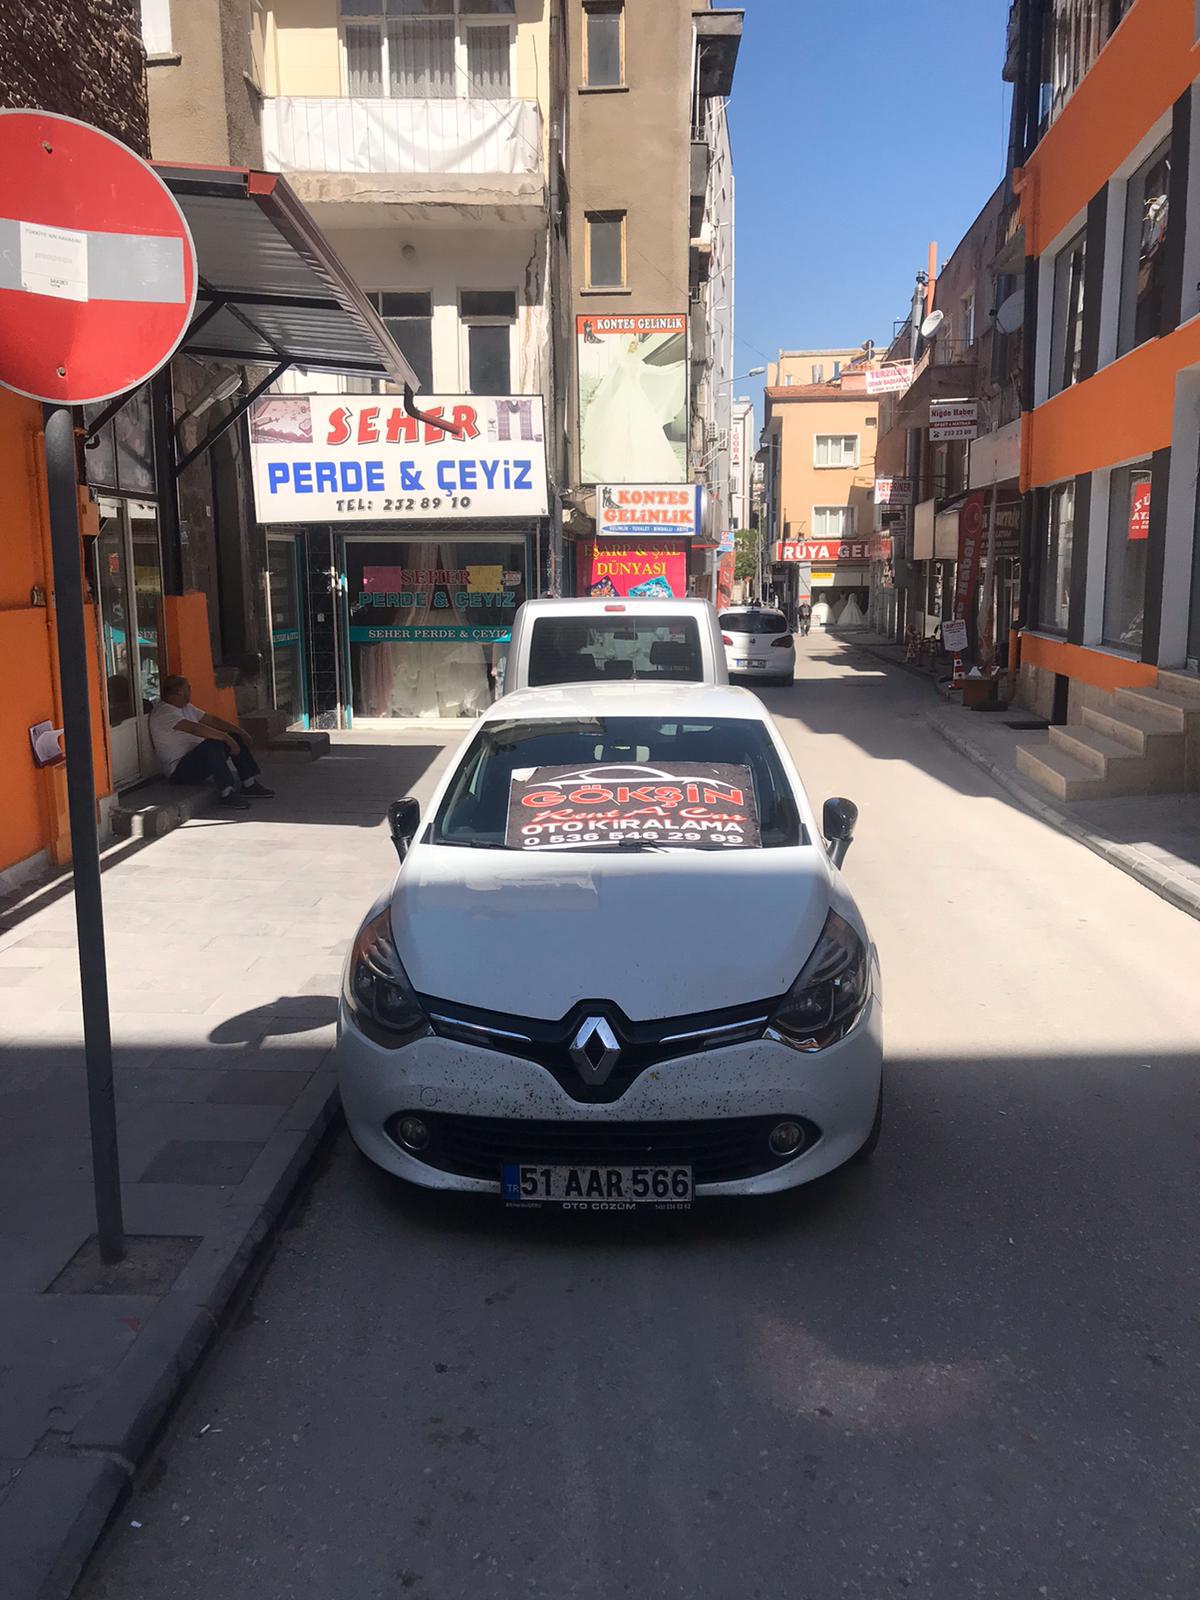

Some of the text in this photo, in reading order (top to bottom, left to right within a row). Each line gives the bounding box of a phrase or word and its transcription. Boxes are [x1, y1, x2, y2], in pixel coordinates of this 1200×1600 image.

[597, 319, 634, 330] KONTES
[327, 405, 480, 445] SEHER
[268, 460, 386, 494] PERDE
[400, 461, 425, 491] &
[336, 496, 471, 512] TEL: 232 89 10
[617, 490, 689, 505] KONTES
[652, 543, 681, 560] ŞAL
[783, 542, 830, 559] RÜYA
[596, 560, 667, 576] DÜNYASI
[401, 569, 473, 586] SEHER
[359, 591, 428, 608] PERDE
[434, 592, 449, 608] &
[368, 629, 411, 639] SEHER
[414, 629, 456, 639] PERDE
[459, 629, 469, 639] &
[523, 830, 744, 847] 0 536 546 29 99
[507, 1183, 519, 1193] TR
[520, 1167, 689, 1198] 51 AAR 566
[562, 1202, 588, 1210] OTO
